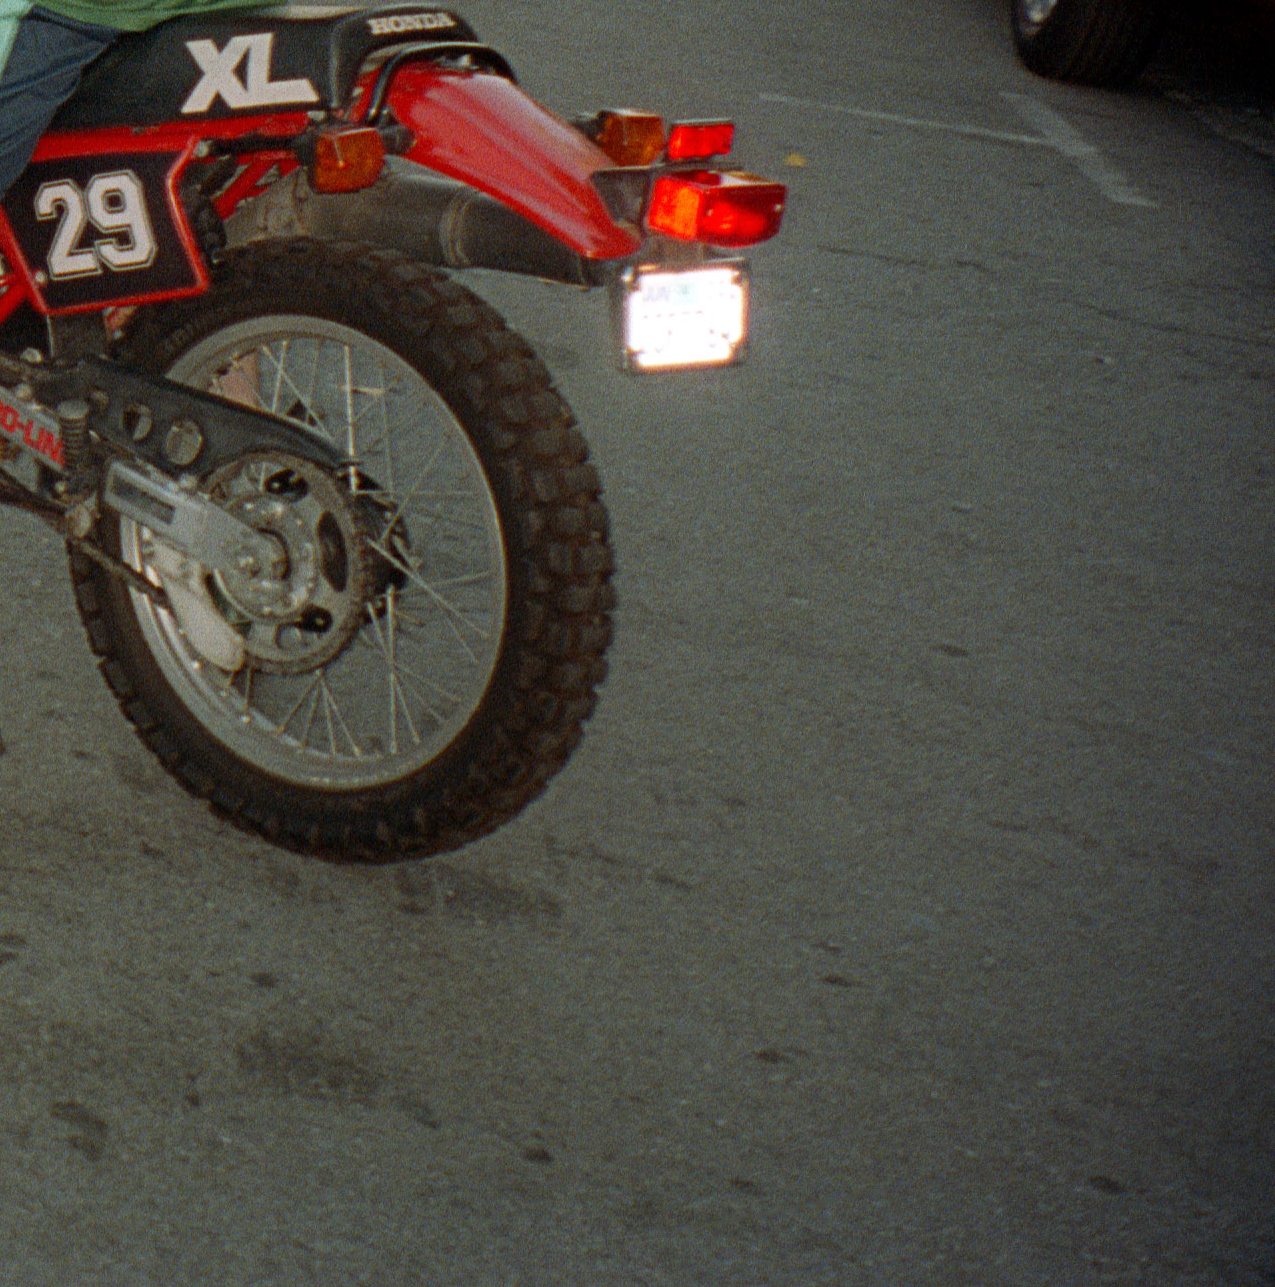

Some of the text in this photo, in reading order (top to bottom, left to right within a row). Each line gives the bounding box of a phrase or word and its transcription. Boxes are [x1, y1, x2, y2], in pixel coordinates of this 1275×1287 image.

[368, 12, 456, 35] HONDA
[180, 32, 320, 114] XL
[34, 169, 158, 281] 29
